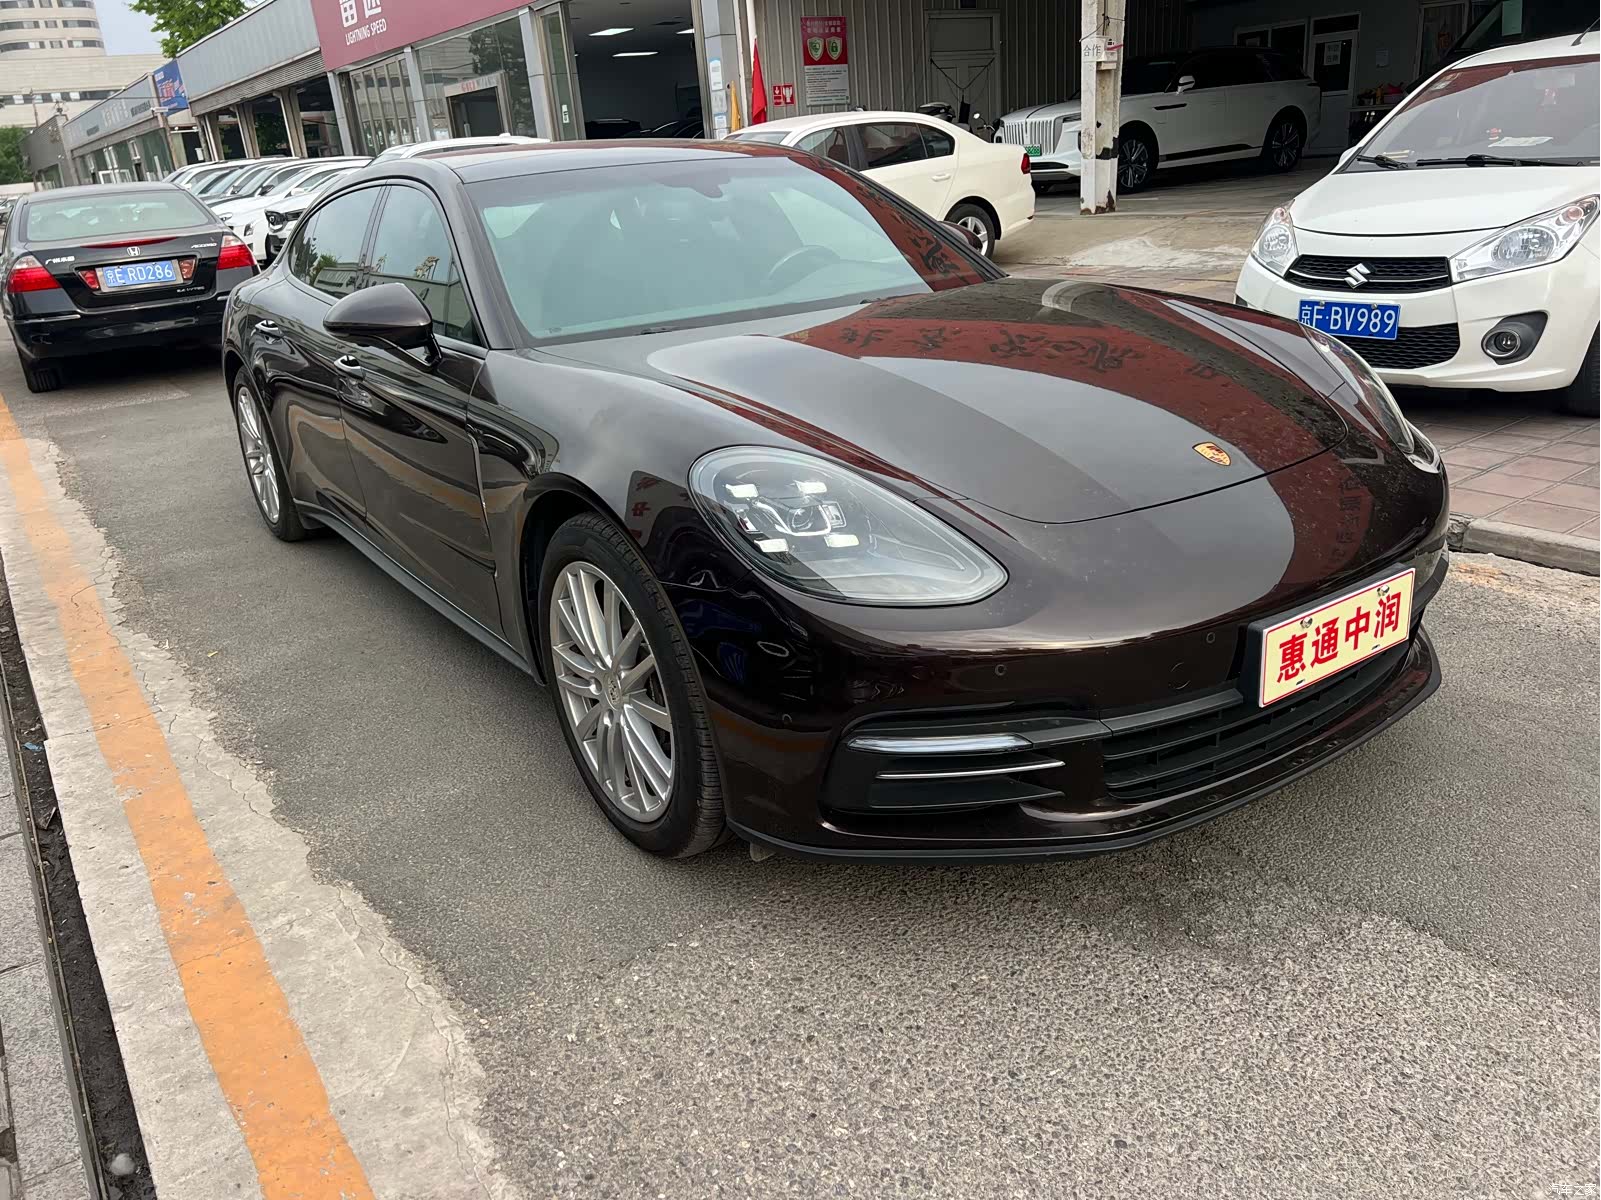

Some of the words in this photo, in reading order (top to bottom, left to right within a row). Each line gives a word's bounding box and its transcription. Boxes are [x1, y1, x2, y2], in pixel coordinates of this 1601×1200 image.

[345, 24, 371, 46] LIGHTNING
[370, 18, 387, 36] SPEED
[1083, 44, 1102, 57] 合作
[1277, 591, 1401, 683] 惠通中润
